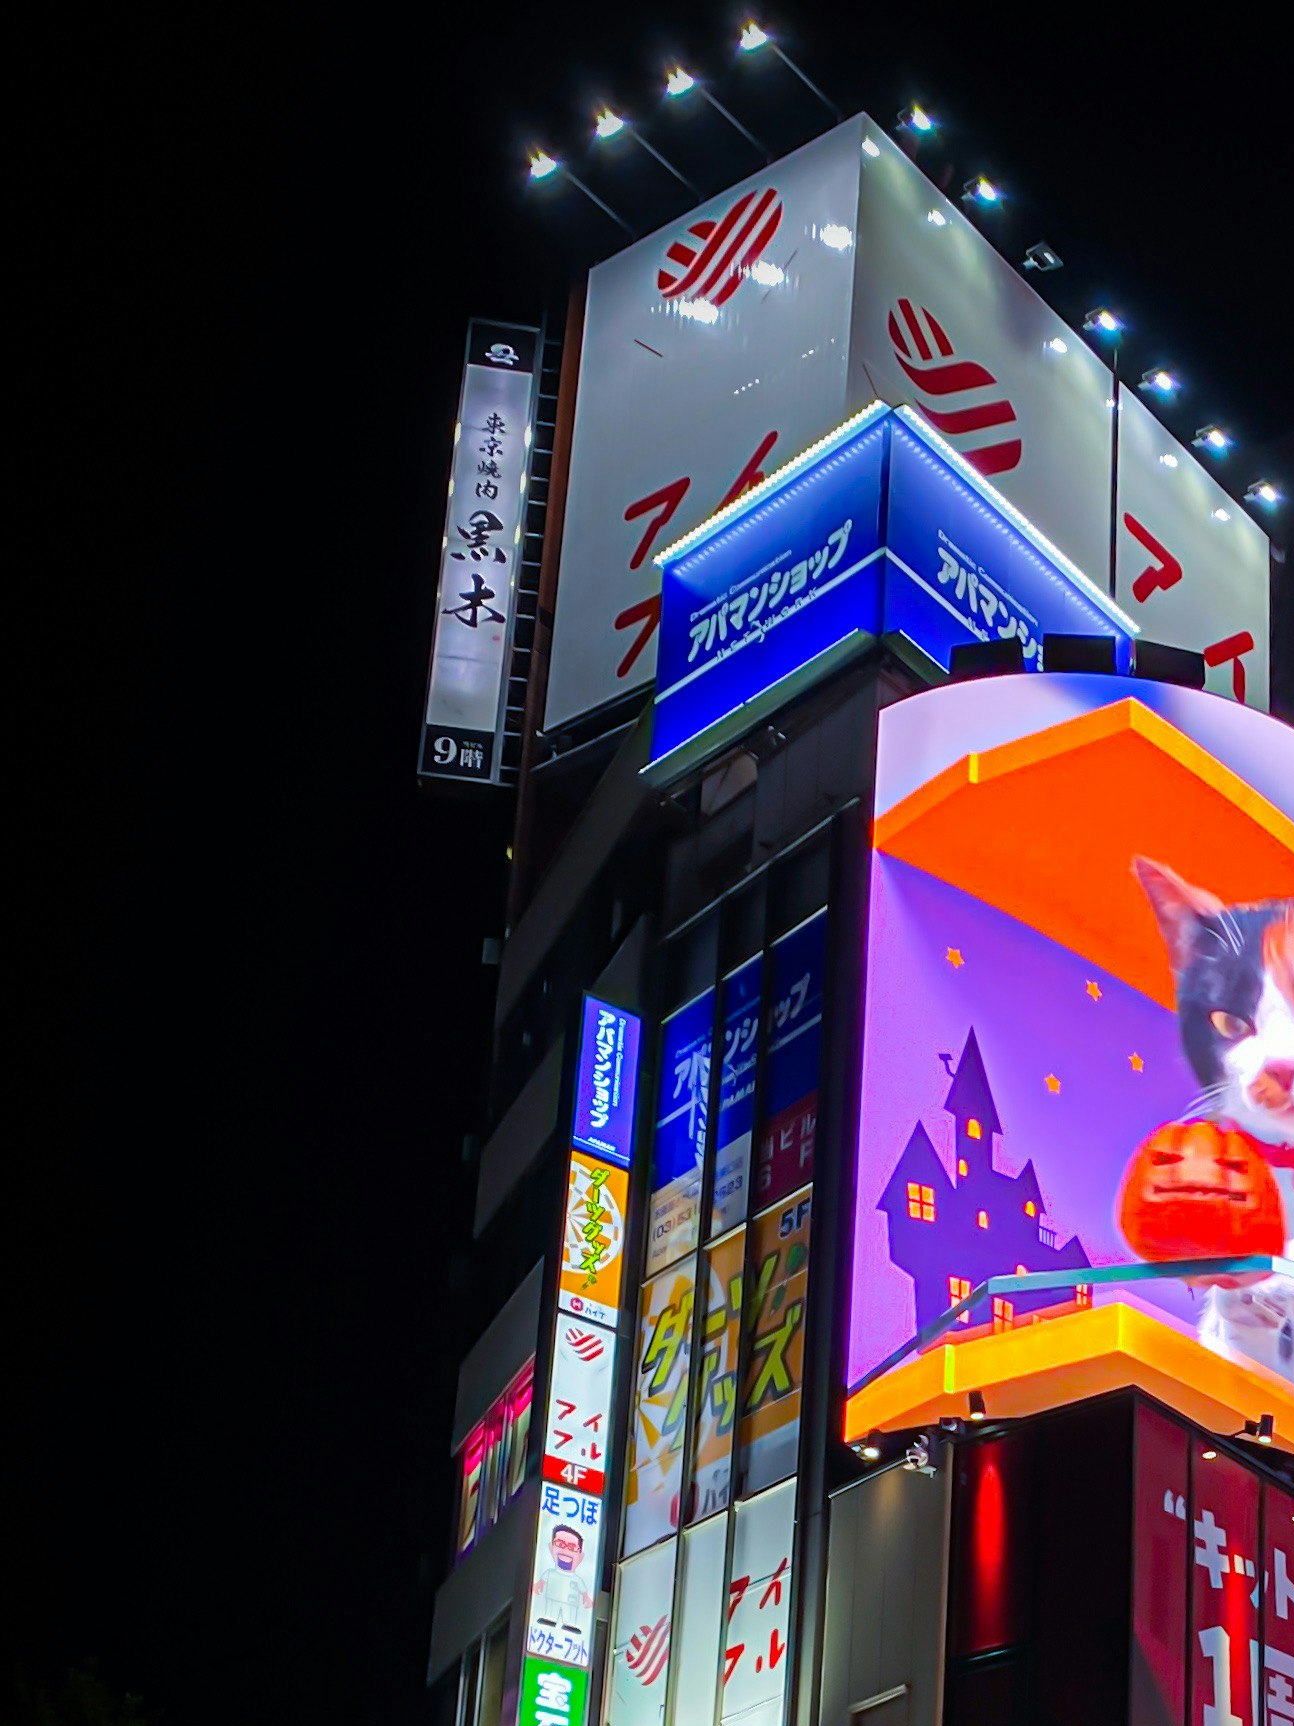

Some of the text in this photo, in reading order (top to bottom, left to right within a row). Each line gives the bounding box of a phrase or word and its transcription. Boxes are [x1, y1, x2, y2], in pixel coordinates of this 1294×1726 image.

[442, 510, 506, 628] 黒木
[687, 519, 853, 663] アパマンショップ
[560, 1464, 588, 1485] 4F
[542, 1485, 600, 1527] 足つぼ
[528, 1625, 588, 1663] ドクターフット
